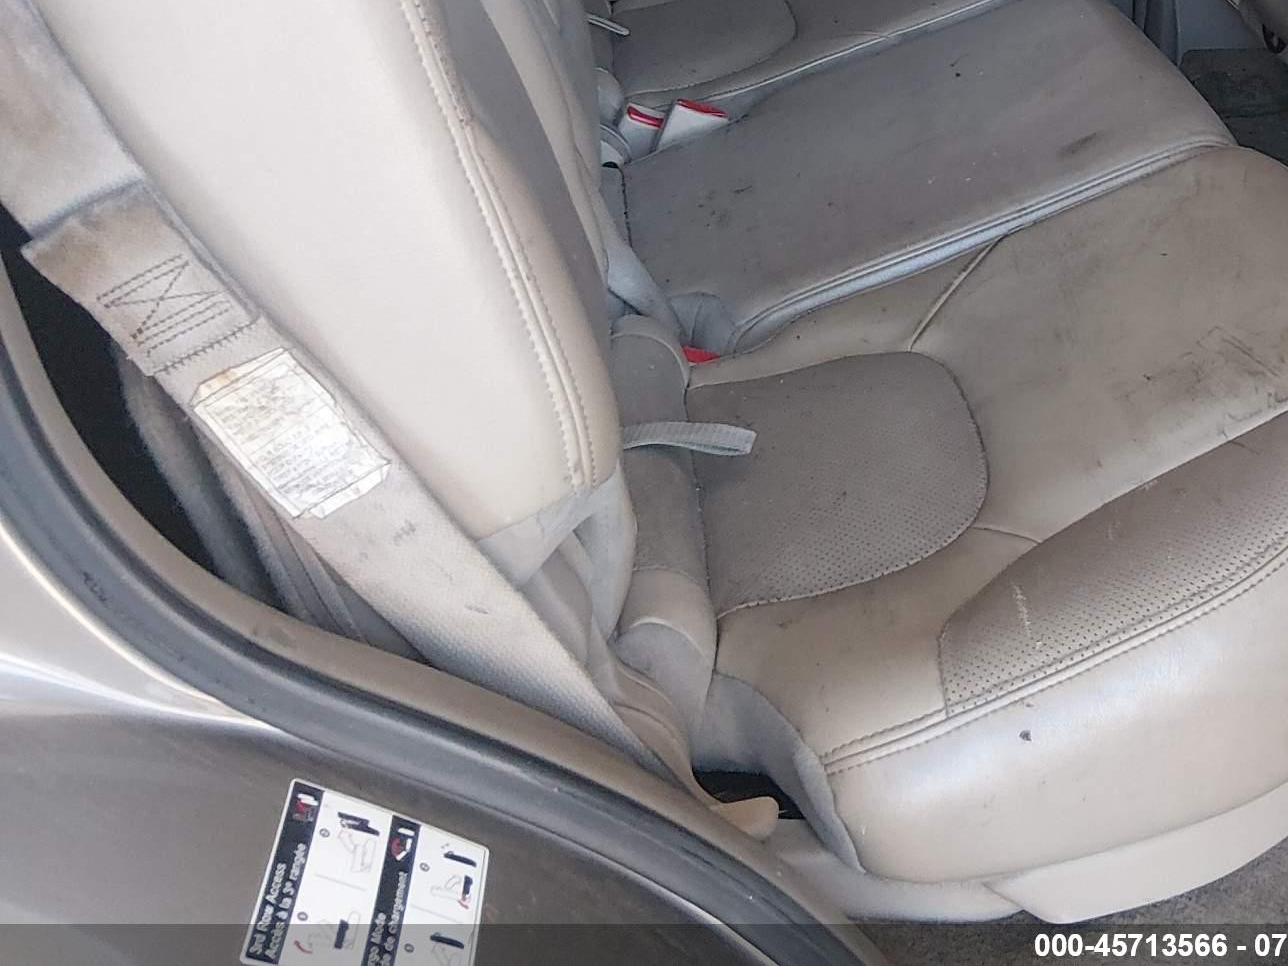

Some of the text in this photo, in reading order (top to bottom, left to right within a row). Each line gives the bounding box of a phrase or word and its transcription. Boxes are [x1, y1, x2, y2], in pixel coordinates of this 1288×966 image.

[256, 903, 274, 932] Row
[265, 863, 287, 904] Access
[370, 912, 386, 945] Mode
